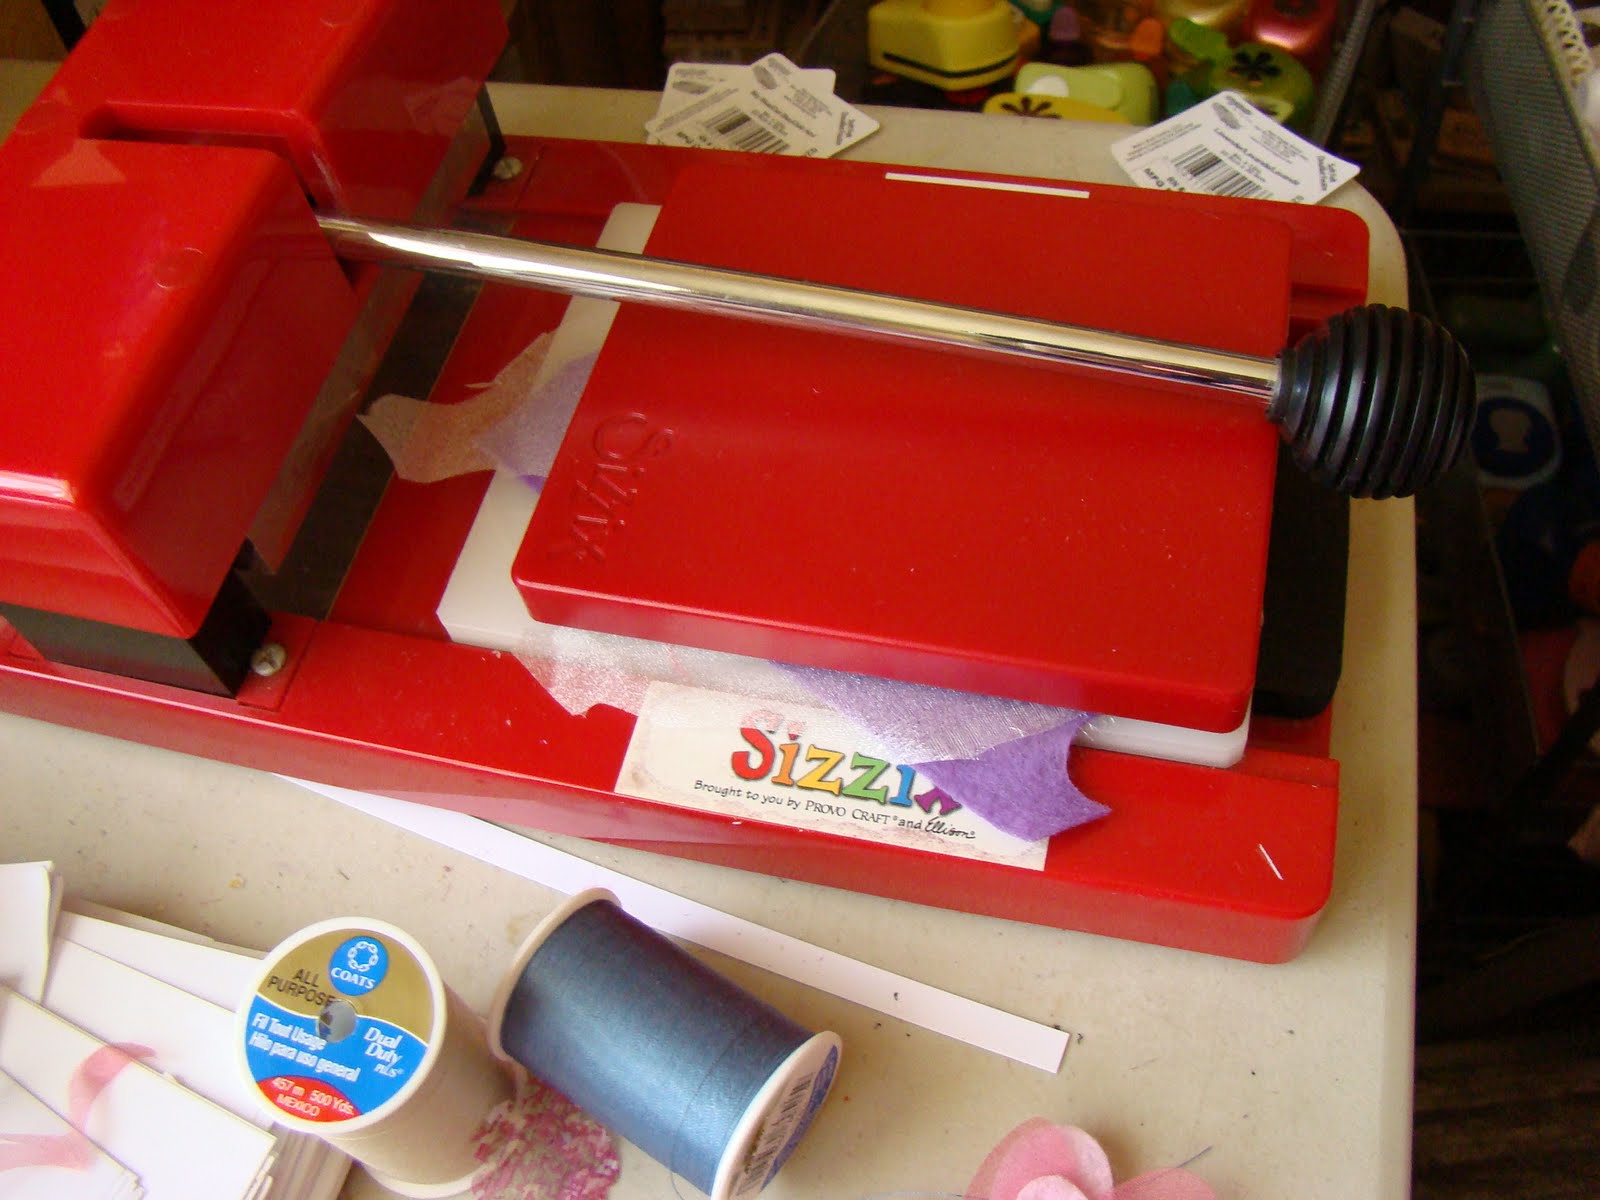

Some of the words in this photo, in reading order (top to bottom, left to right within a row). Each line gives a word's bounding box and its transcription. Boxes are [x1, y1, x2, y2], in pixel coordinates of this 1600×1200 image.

[693, 780, 742, 798] Brought
[746, 791, 759, 801] to
[761, 794, 783, 805] you
[786, 796, 801, 810] by
[805, 800, 847, 817] PROVO
[898, 818, 922, 830] and
[293, 969, 319, 988] ALL
[331, 967, 376, 989] COATS
[291, 1026, 327, 1051] Usage
[364, 1026, 403, 1049] Dual
[269, 1042, 298, 1060] para
[296, 1051, 318, 1067] uso
[315, 1058, 361, 1082] general
[365, 1042, 403, 1072] Duty
[272, 1077, 295, 1091] 457
[310, 1090, 332, 1106] 500
[276, 1094, 320, 1117] MEXICO
